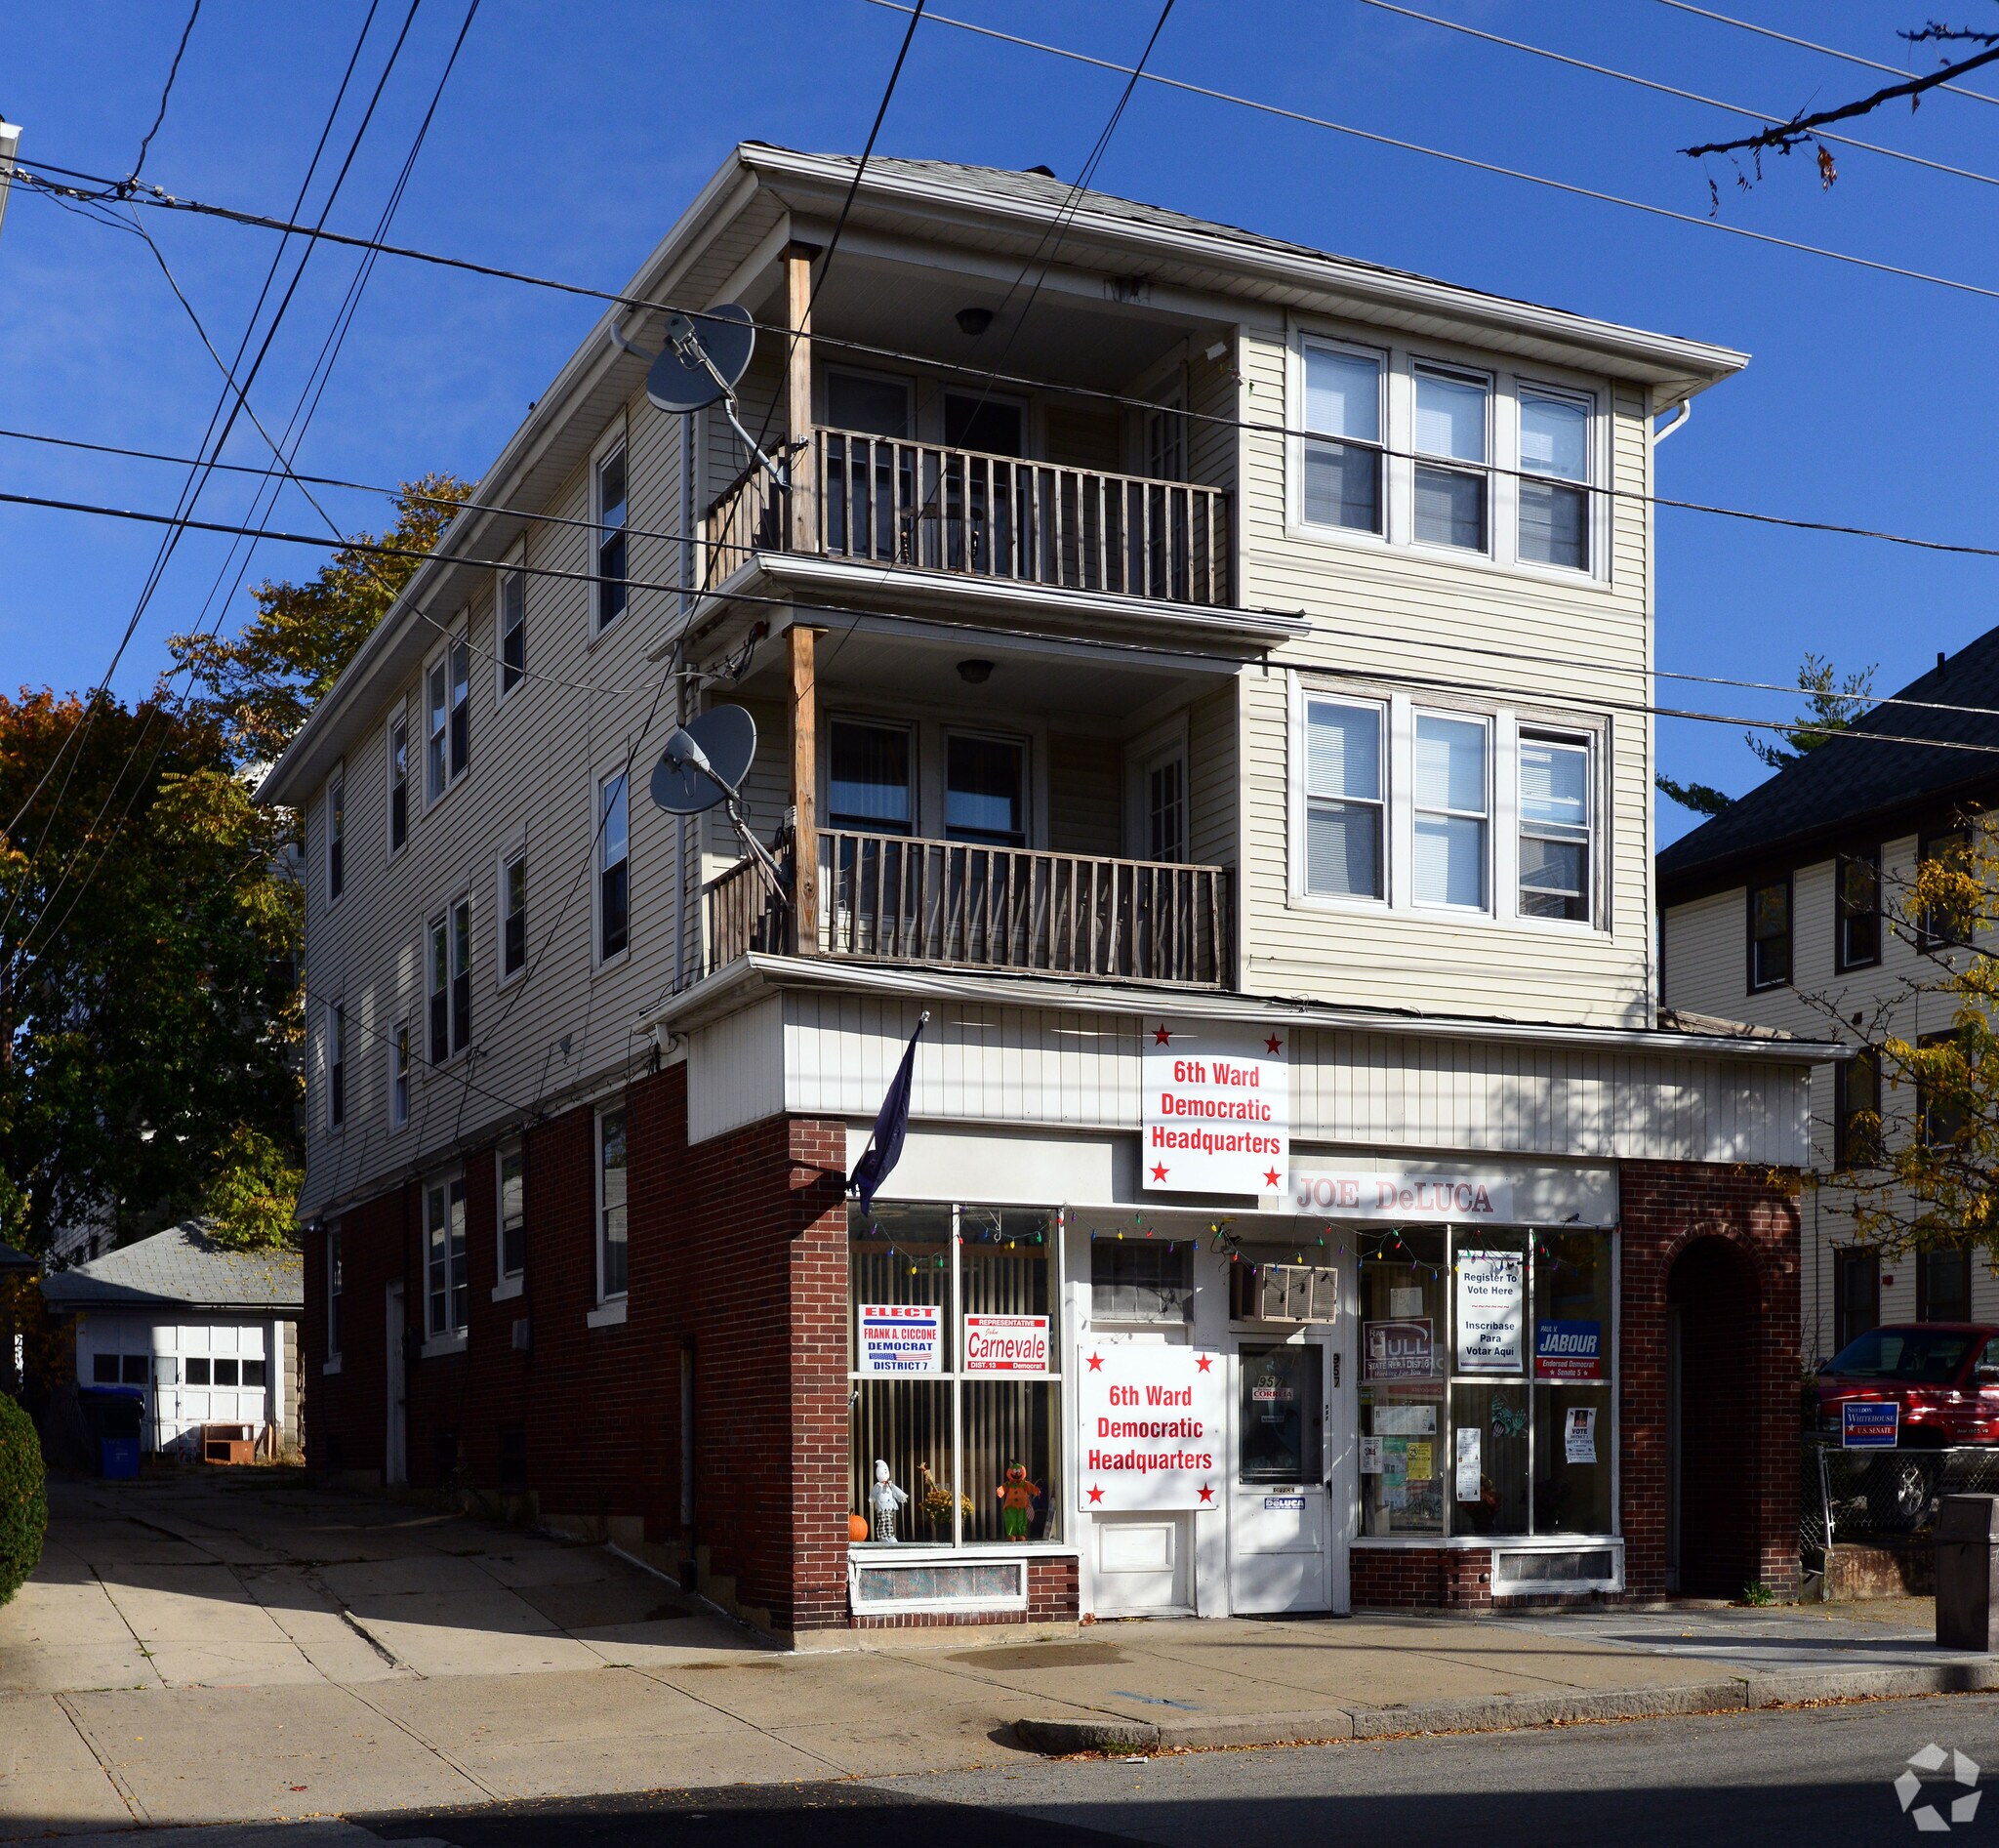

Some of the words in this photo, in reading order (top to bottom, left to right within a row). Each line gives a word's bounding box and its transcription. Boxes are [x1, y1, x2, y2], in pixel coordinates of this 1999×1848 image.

[1174, 1060, 1205, 1083] 6th
[1212, 1062, 1259, 1088] Ward
[1162, 1092, 1271, 1121] Democratic
[1152, 1126, 1281, 1155] Headquarters
[1296, 1177, 1360, 1209] JOE
[1375, 1180, 1494, 1213] DeLUCA
[1464, 1272, 1504, 1284] Register
[1506, 1274, 1518, 1283] To
[1467, 1286, 1489, 1294] Vote
[1491, 1286, 1514, 1295] Here
[865, 1307, 935, 1317] ELECT
[864, 1328, 890, 1339] FRANK
[892, 1329, 899, 1339] A.
[901, 1329, 936, 1340] CICCONE
[1480, 1334, 1502, 1343] Para
[868, 1341, 933, 1351] DEMOCRAT
[968, 1332, 1045, 1359] Carnevale
[1369, 1336, 1429, 1357] HULL
[1539, 1334, 1598, 1353] JABOUR
[1466, 1346, 1491, 1356] Votar
[1494, 1346, 1514, 1357] Aquí
[874, 1361, 920, 1371] DISTRICT
[922, 1362, 928, 1371] 7
[1258, 1376, 1283, 1387] 957
[1109, 1385, 1139, 1406] 6th
[1146, 1385, 1192, 1406] Ward
[1848, 1414, 1895, 1422] WHITEHOUSE
[1098, 1417, 1203, 1438] Democratic
[1088, 1449, 1212, 1475] Headquarters
